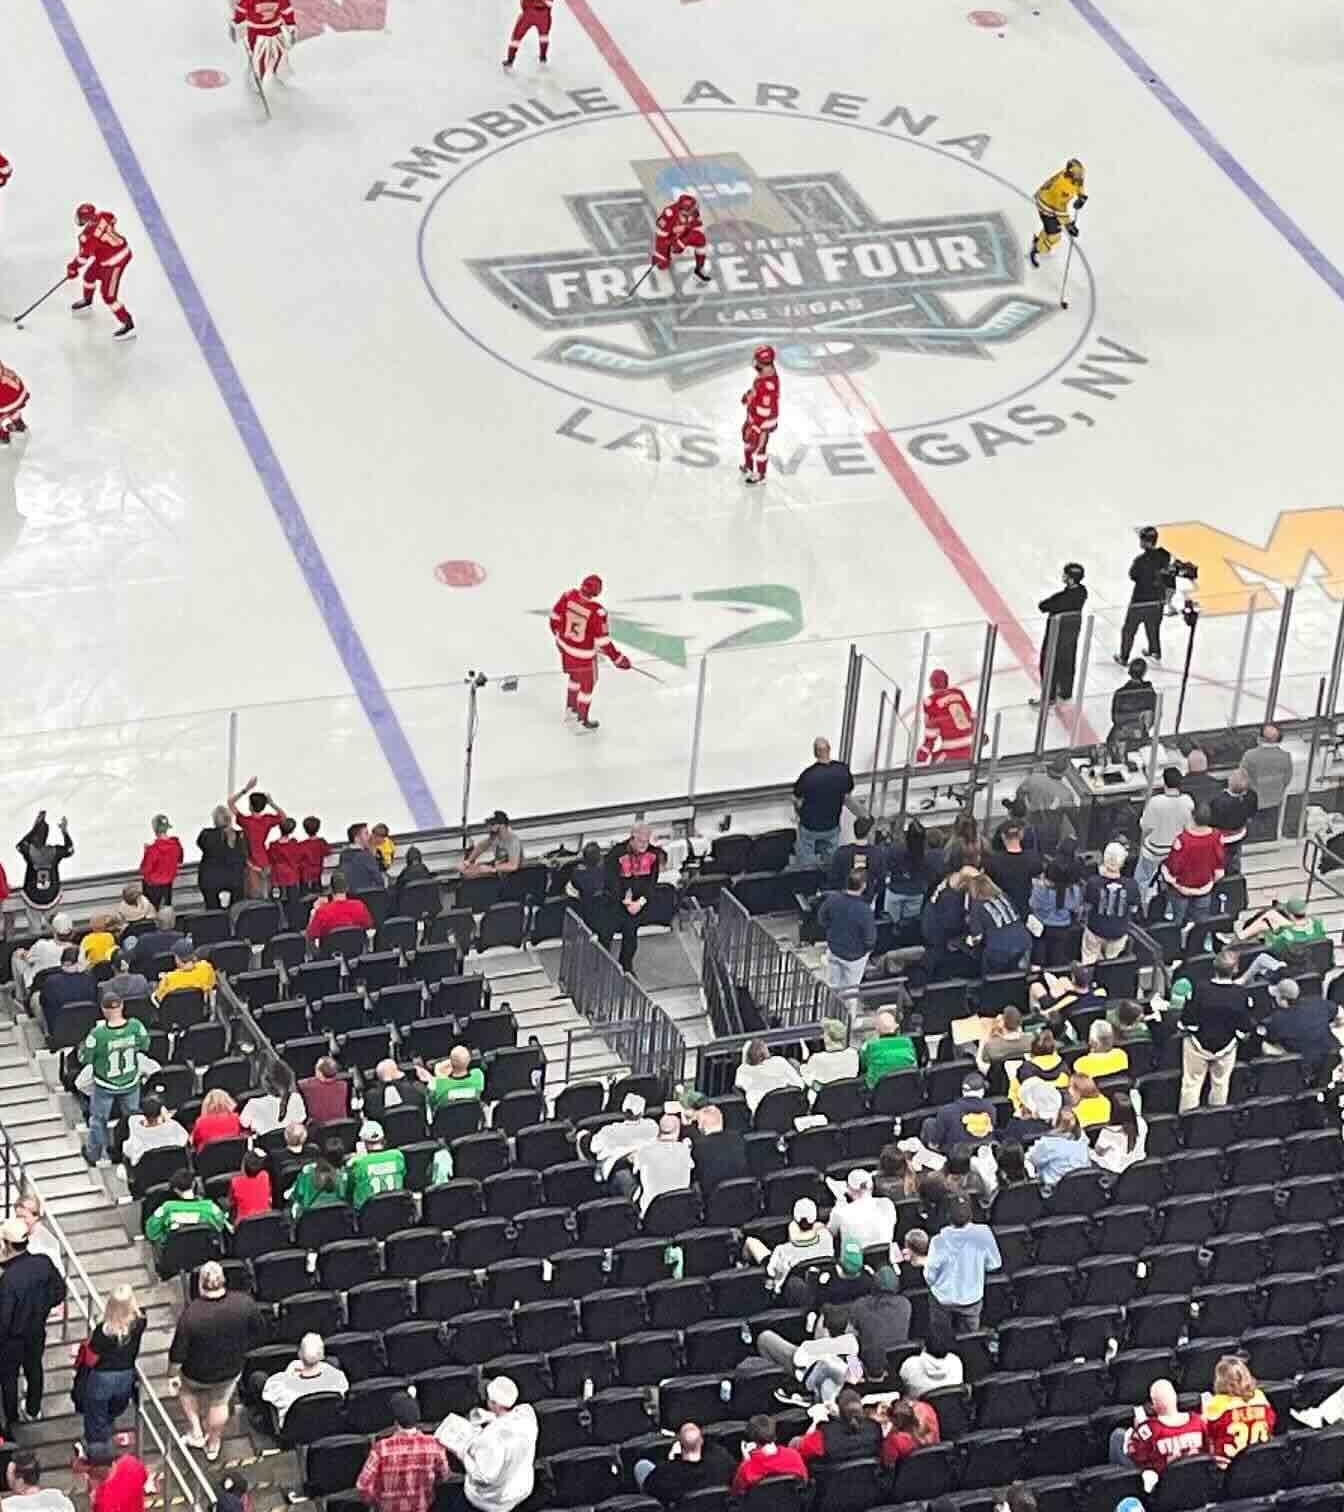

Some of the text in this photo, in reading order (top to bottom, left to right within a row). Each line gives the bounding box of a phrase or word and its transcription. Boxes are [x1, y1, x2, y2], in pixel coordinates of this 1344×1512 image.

[364, 79, 993, 208] T-MOBILE ARENA
[816, 234, 987, 282] FOUR
[557, 406, 722, 470] LAS
[1061, 335, 1150, 401] NV
[107, 1046, 136, 1078] 11
